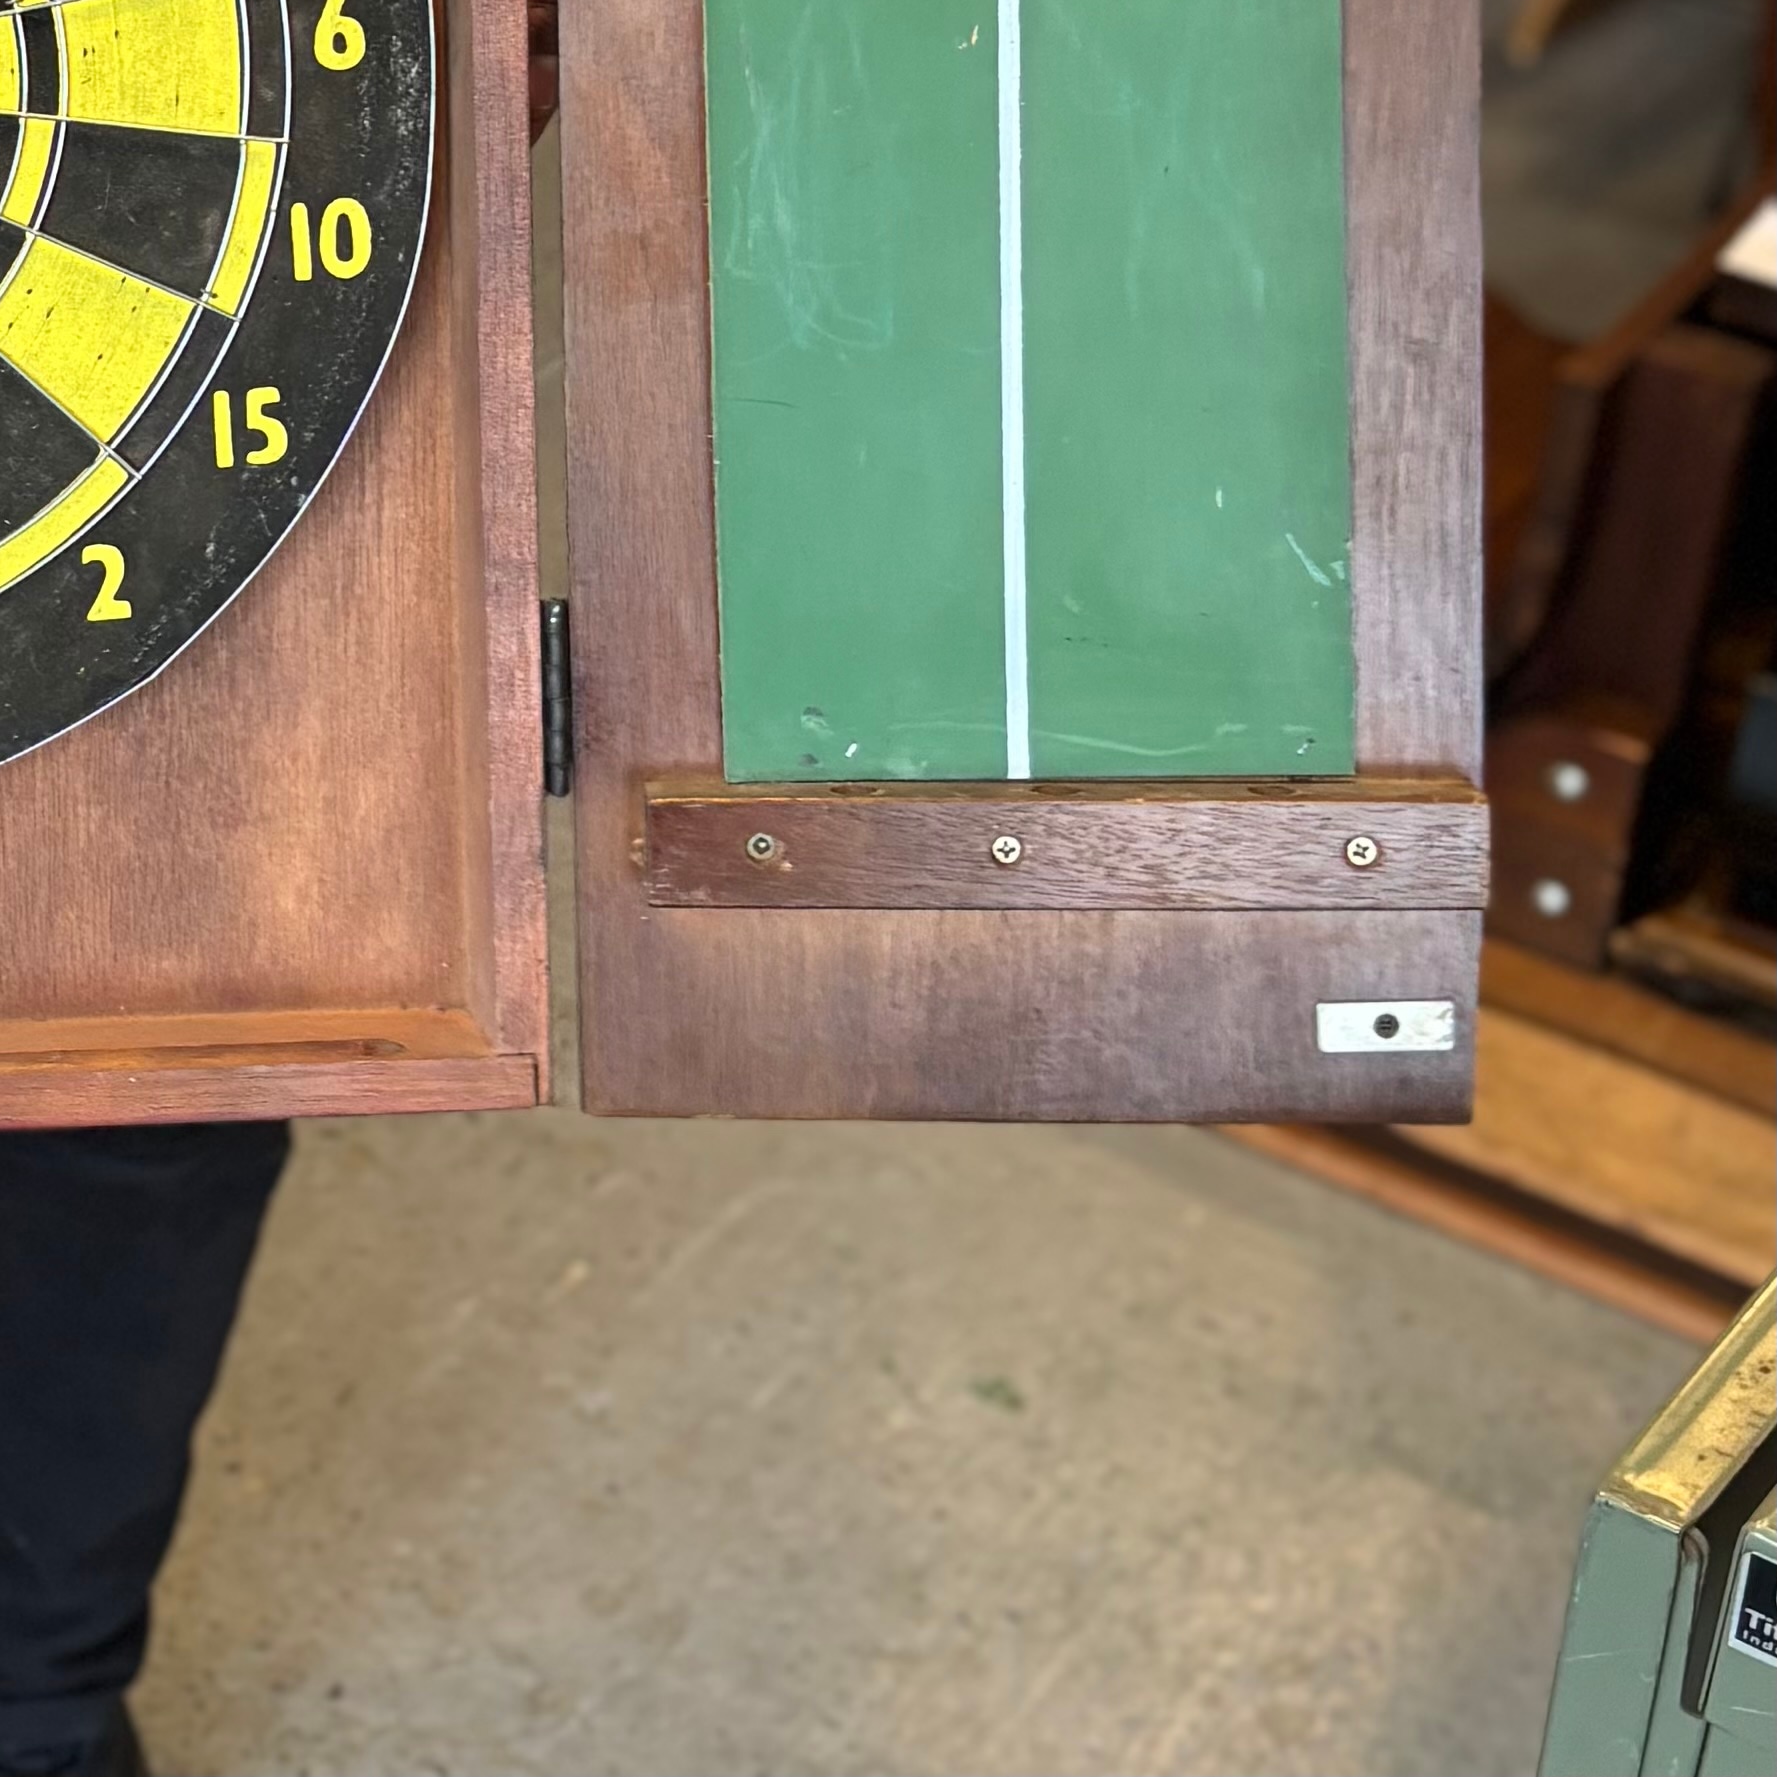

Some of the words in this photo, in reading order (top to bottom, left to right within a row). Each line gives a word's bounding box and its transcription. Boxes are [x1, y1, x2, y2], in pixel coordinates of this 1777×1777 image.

[290, 198, 372, 281] 10
[212, 387, 287, 469] 15
[81, 544, 132, 622] 2
[1745, 1607, 1777, 1640] Ti
